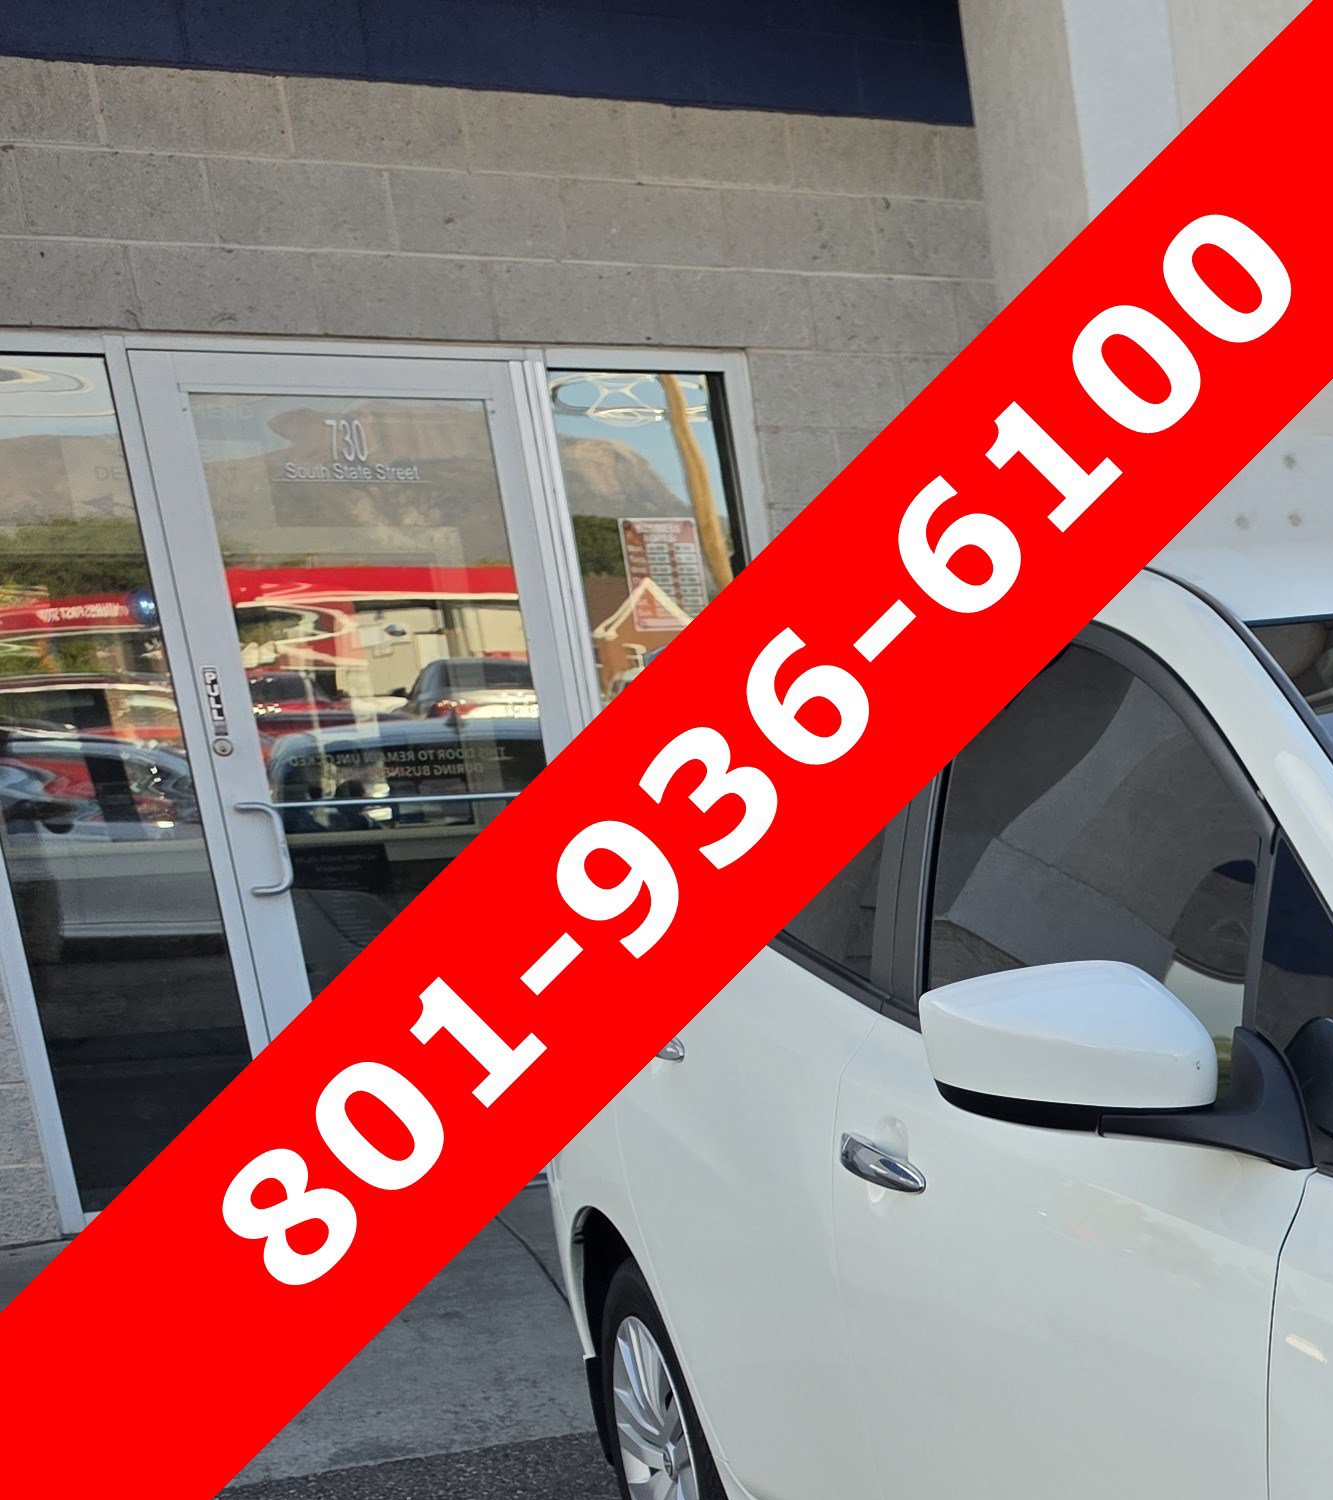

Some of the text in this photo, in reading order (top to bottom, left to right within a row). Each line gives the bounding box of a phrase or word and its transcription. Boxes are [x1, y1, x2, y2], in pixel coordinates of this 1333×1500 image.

[324, 419, 369, 461] 730
[284, 461, 421, 481] South State Street
[203, 671, 225, 721] PULL
